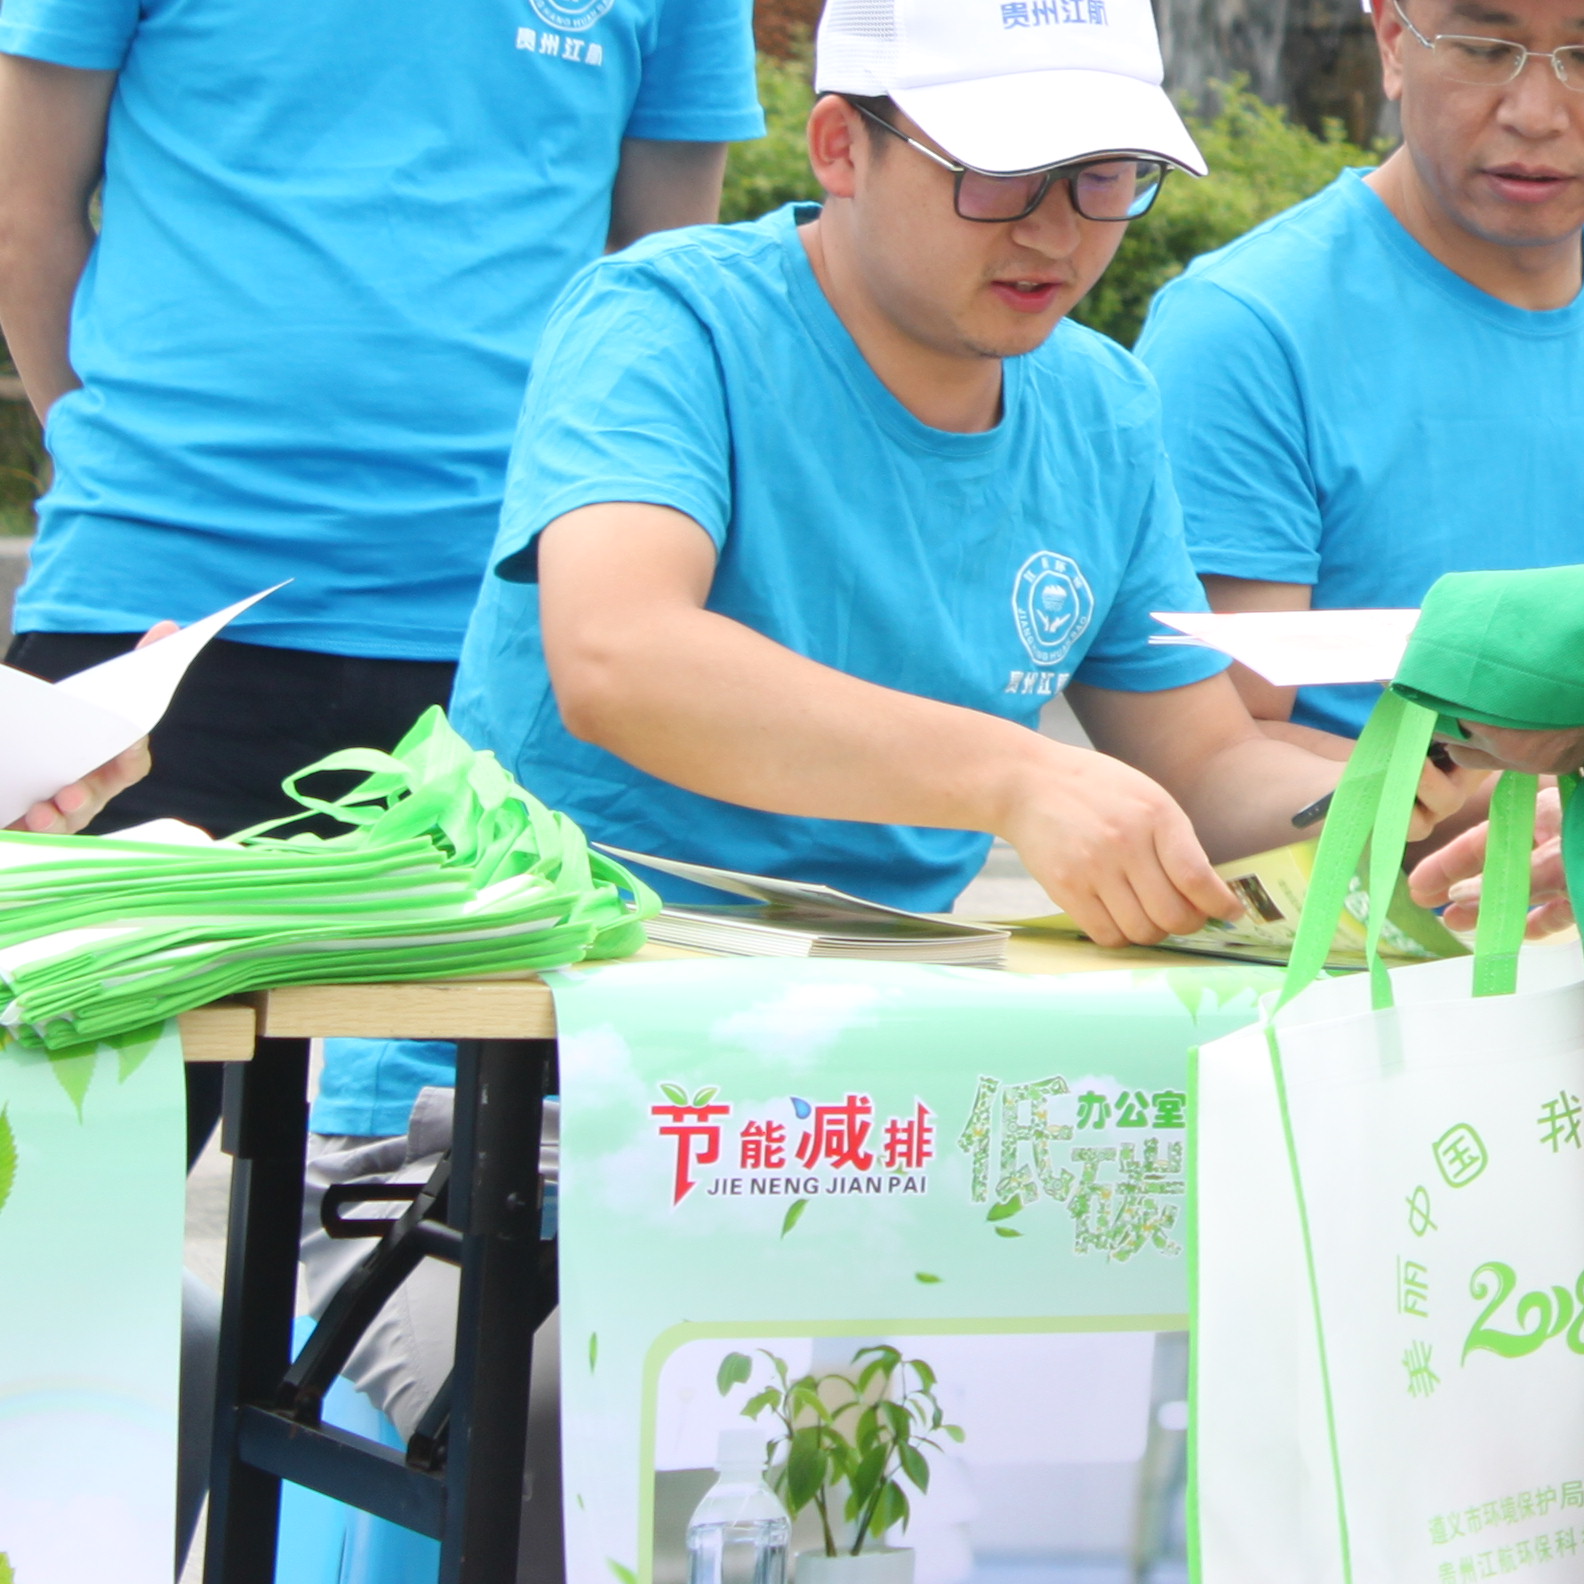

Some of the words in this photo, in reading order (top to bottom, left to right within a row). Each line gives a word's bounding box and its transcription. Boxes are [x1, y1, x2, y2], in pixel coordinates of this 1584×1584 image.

[1076, 1090, 1187, 1130] 办公室
[651, 1088, 933, 1206] 节能减排
[707, 1178, 743, 1196] JIE
[750, 1177, 820, 1195] NENG
[825, 1176, 882, 1194] JIAN
[888, 1175, 927, 1193] PAI
